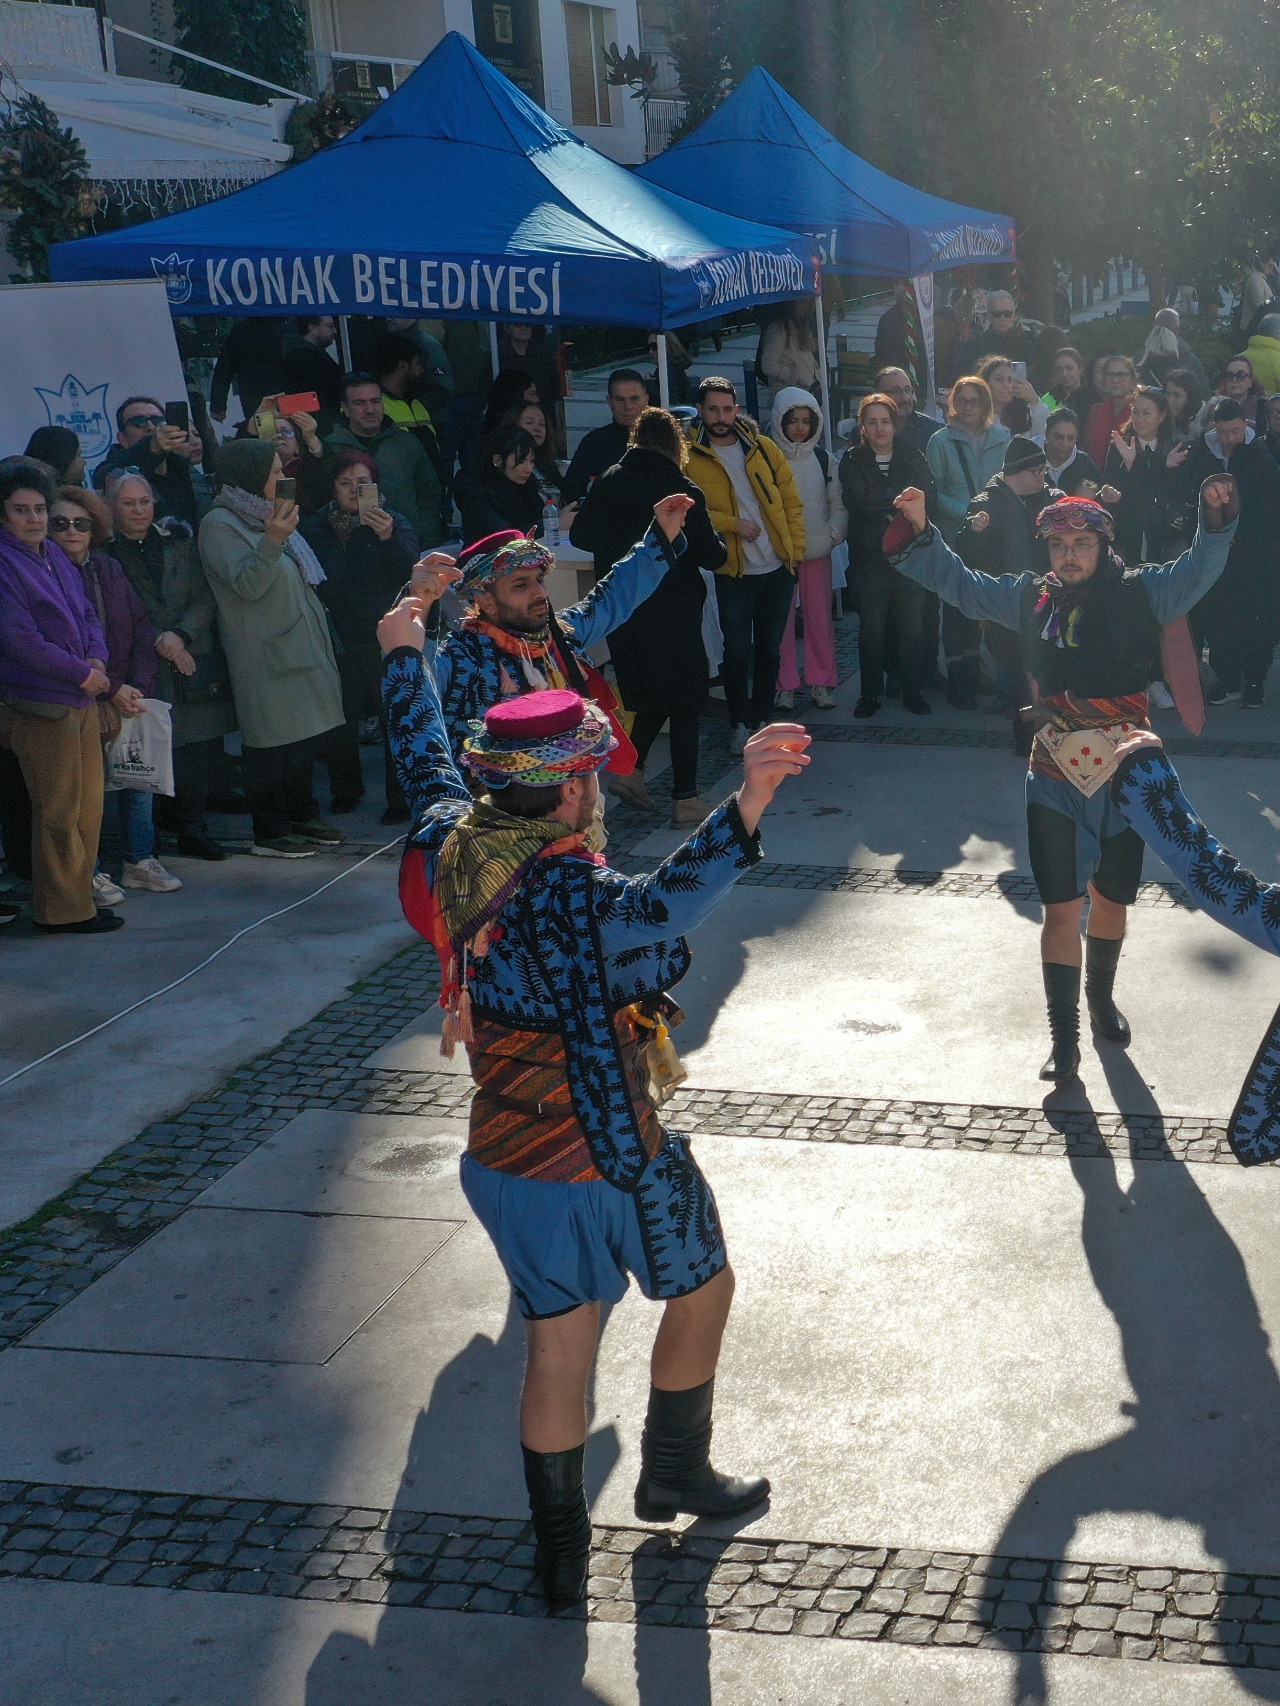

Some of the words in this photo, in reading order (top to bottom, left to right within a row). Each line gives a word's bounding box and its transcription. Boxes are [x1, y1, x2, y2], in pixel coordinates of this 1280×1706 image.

[207, 255, 341, 306] KONAK
[353, 253, 562, 316] BELEDİYESİ
[706, 251, 750, 306] KONAK
[113, 762, 156, 773] arkabahçe
